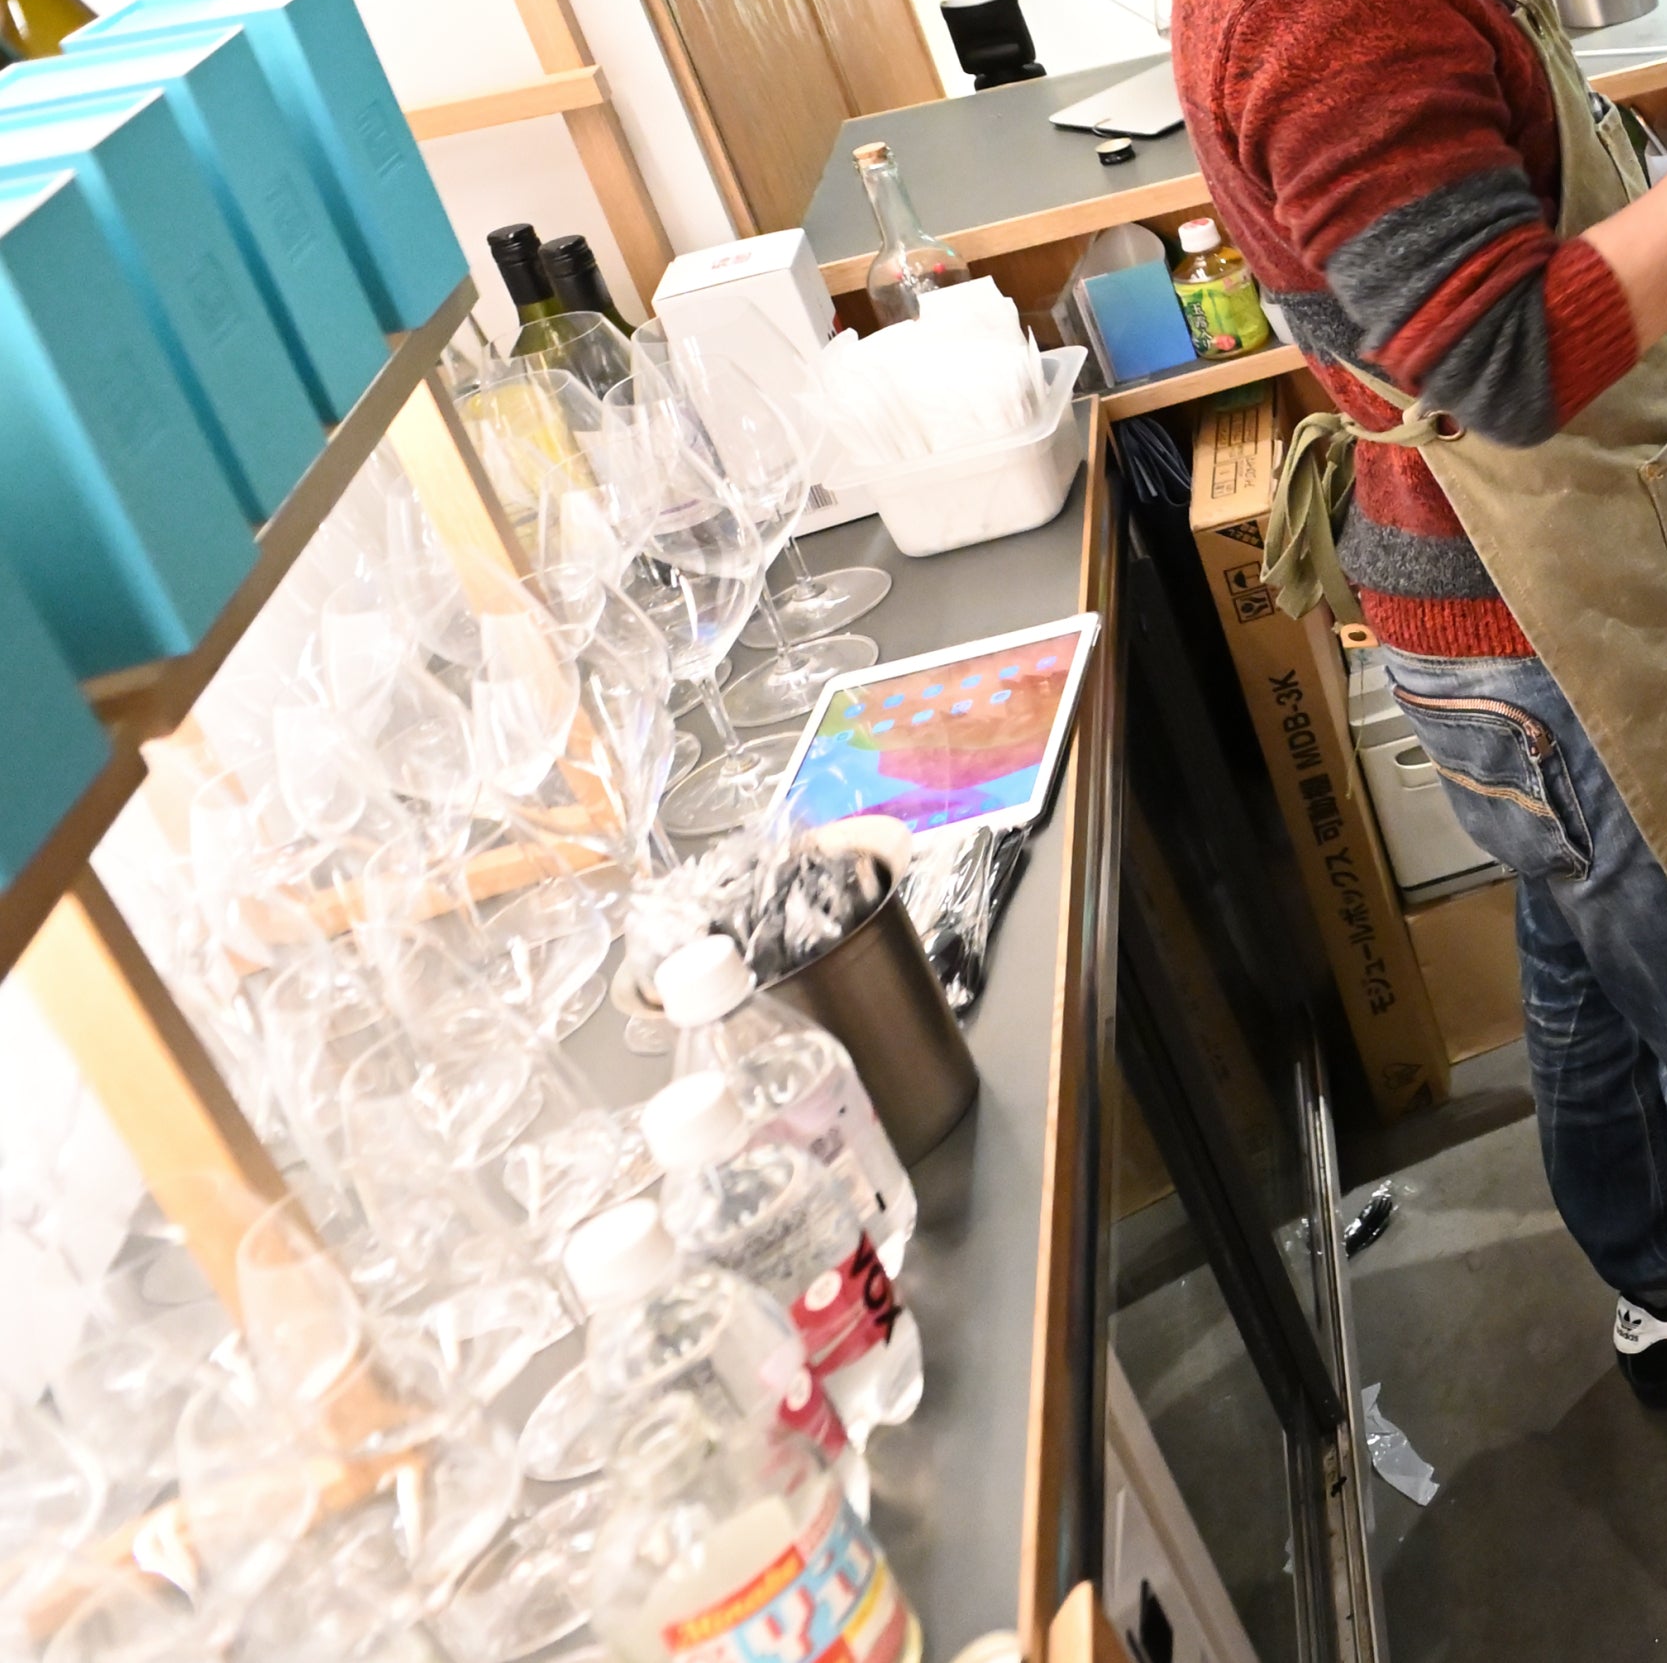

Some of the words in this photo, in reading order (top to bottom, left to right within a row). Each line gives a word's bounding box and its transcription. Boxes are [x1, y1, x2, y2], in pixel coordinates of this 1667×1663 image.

[1269, 669, 1321, 770] MDB-3K
[1325, 847, 1396, 1016] モジュールボックス
